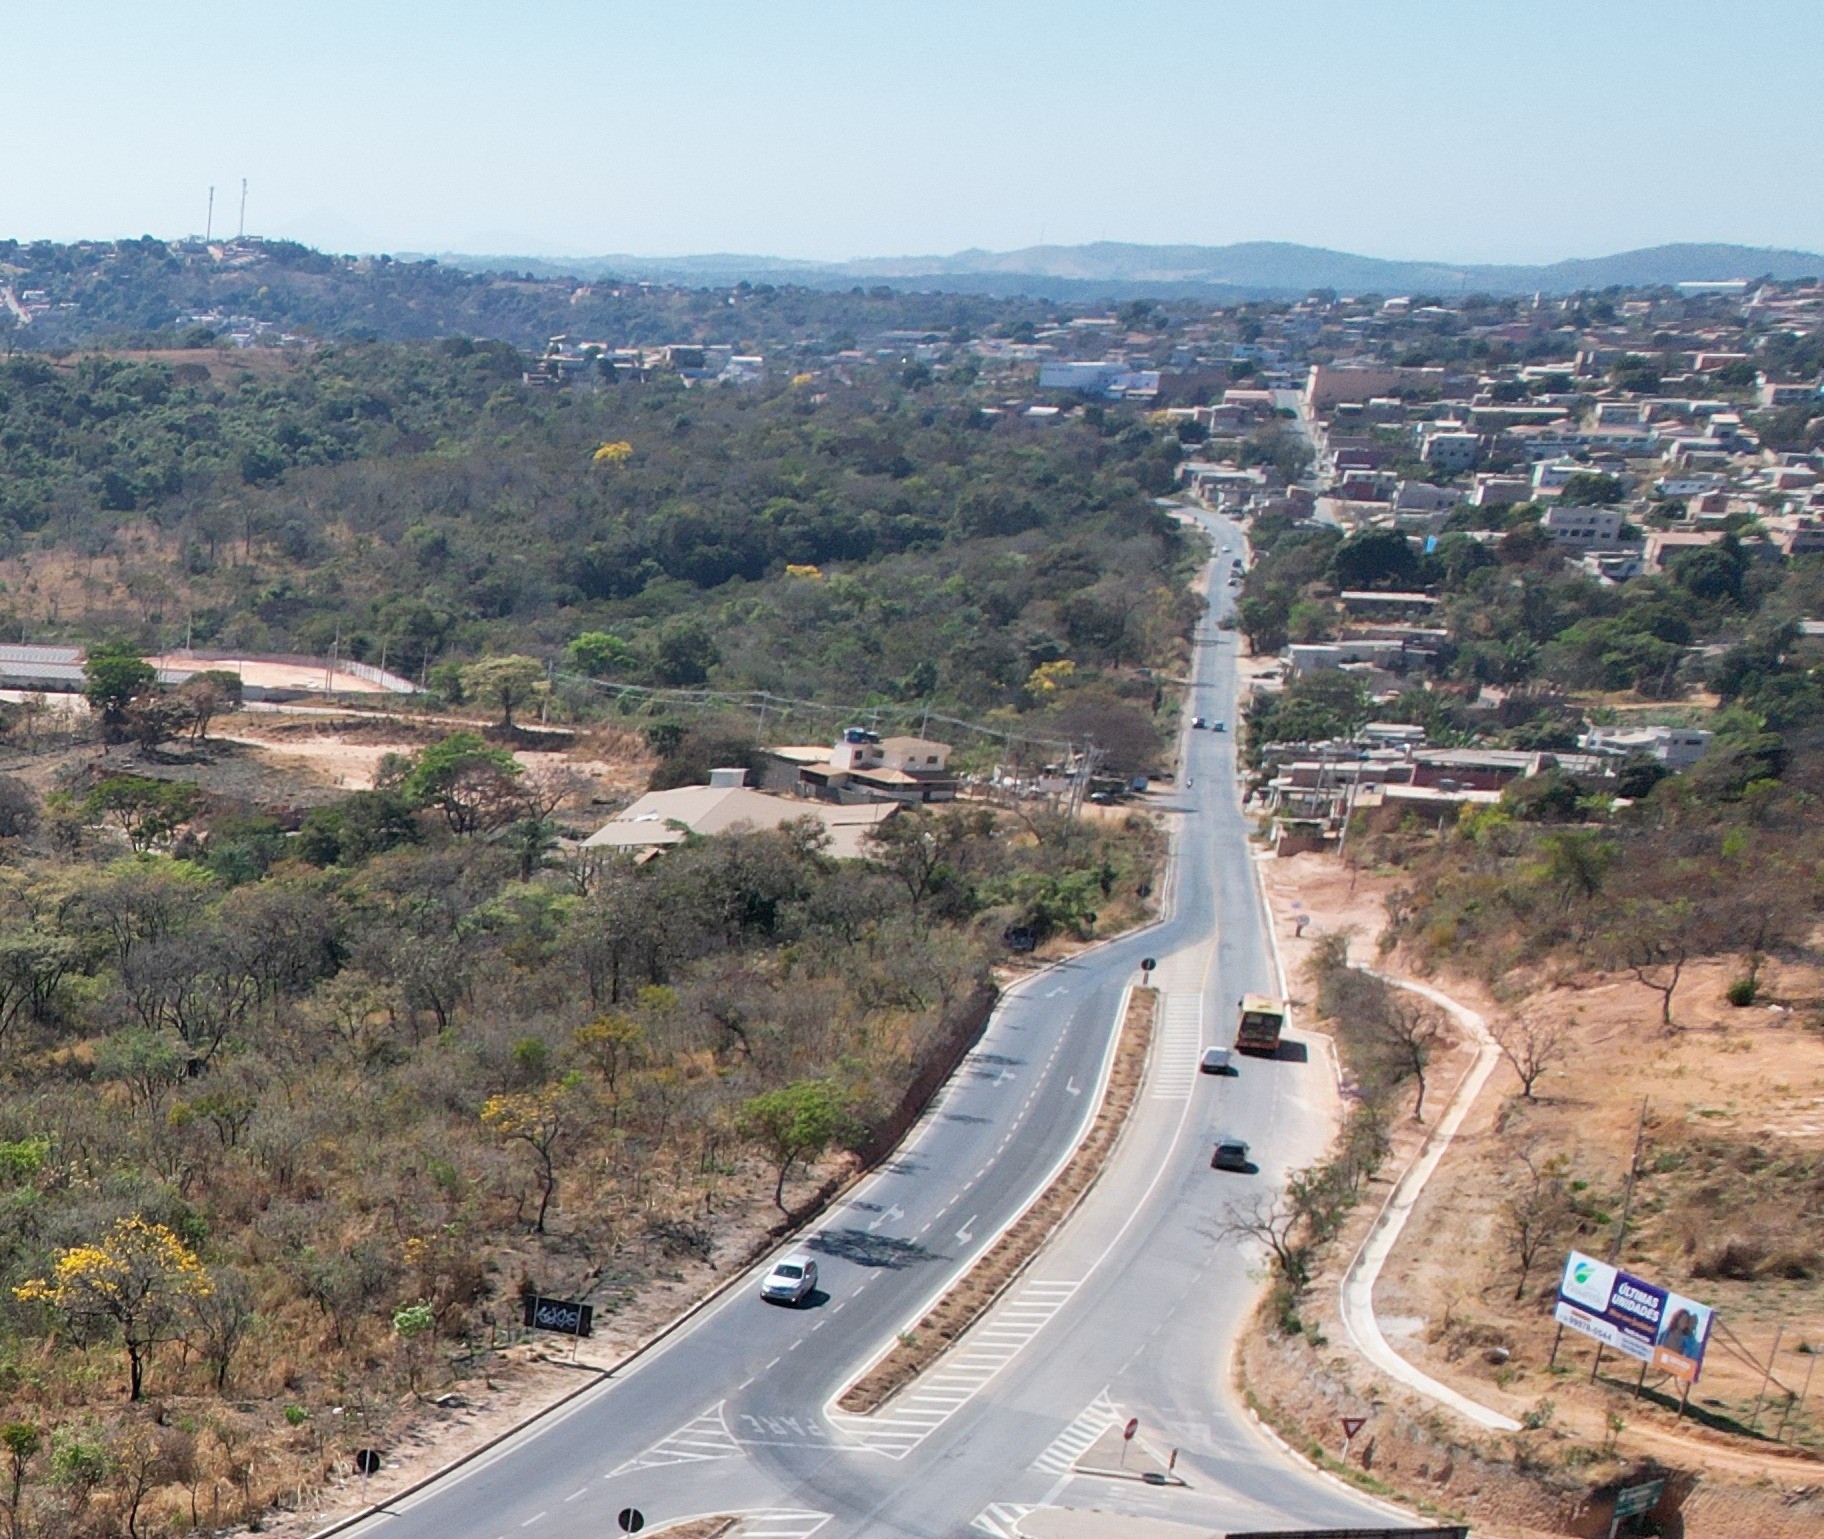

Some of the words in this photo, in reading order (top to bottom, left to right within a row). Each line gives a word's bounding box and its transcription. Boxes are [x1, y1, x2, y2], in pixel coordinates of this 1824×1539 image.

[1611, 1293, 1660, 1322] UNIDADES
[1618, 1282, 1659, 1308] ÚLTIMAS
[740, 1414, 825, 1436] PARE
